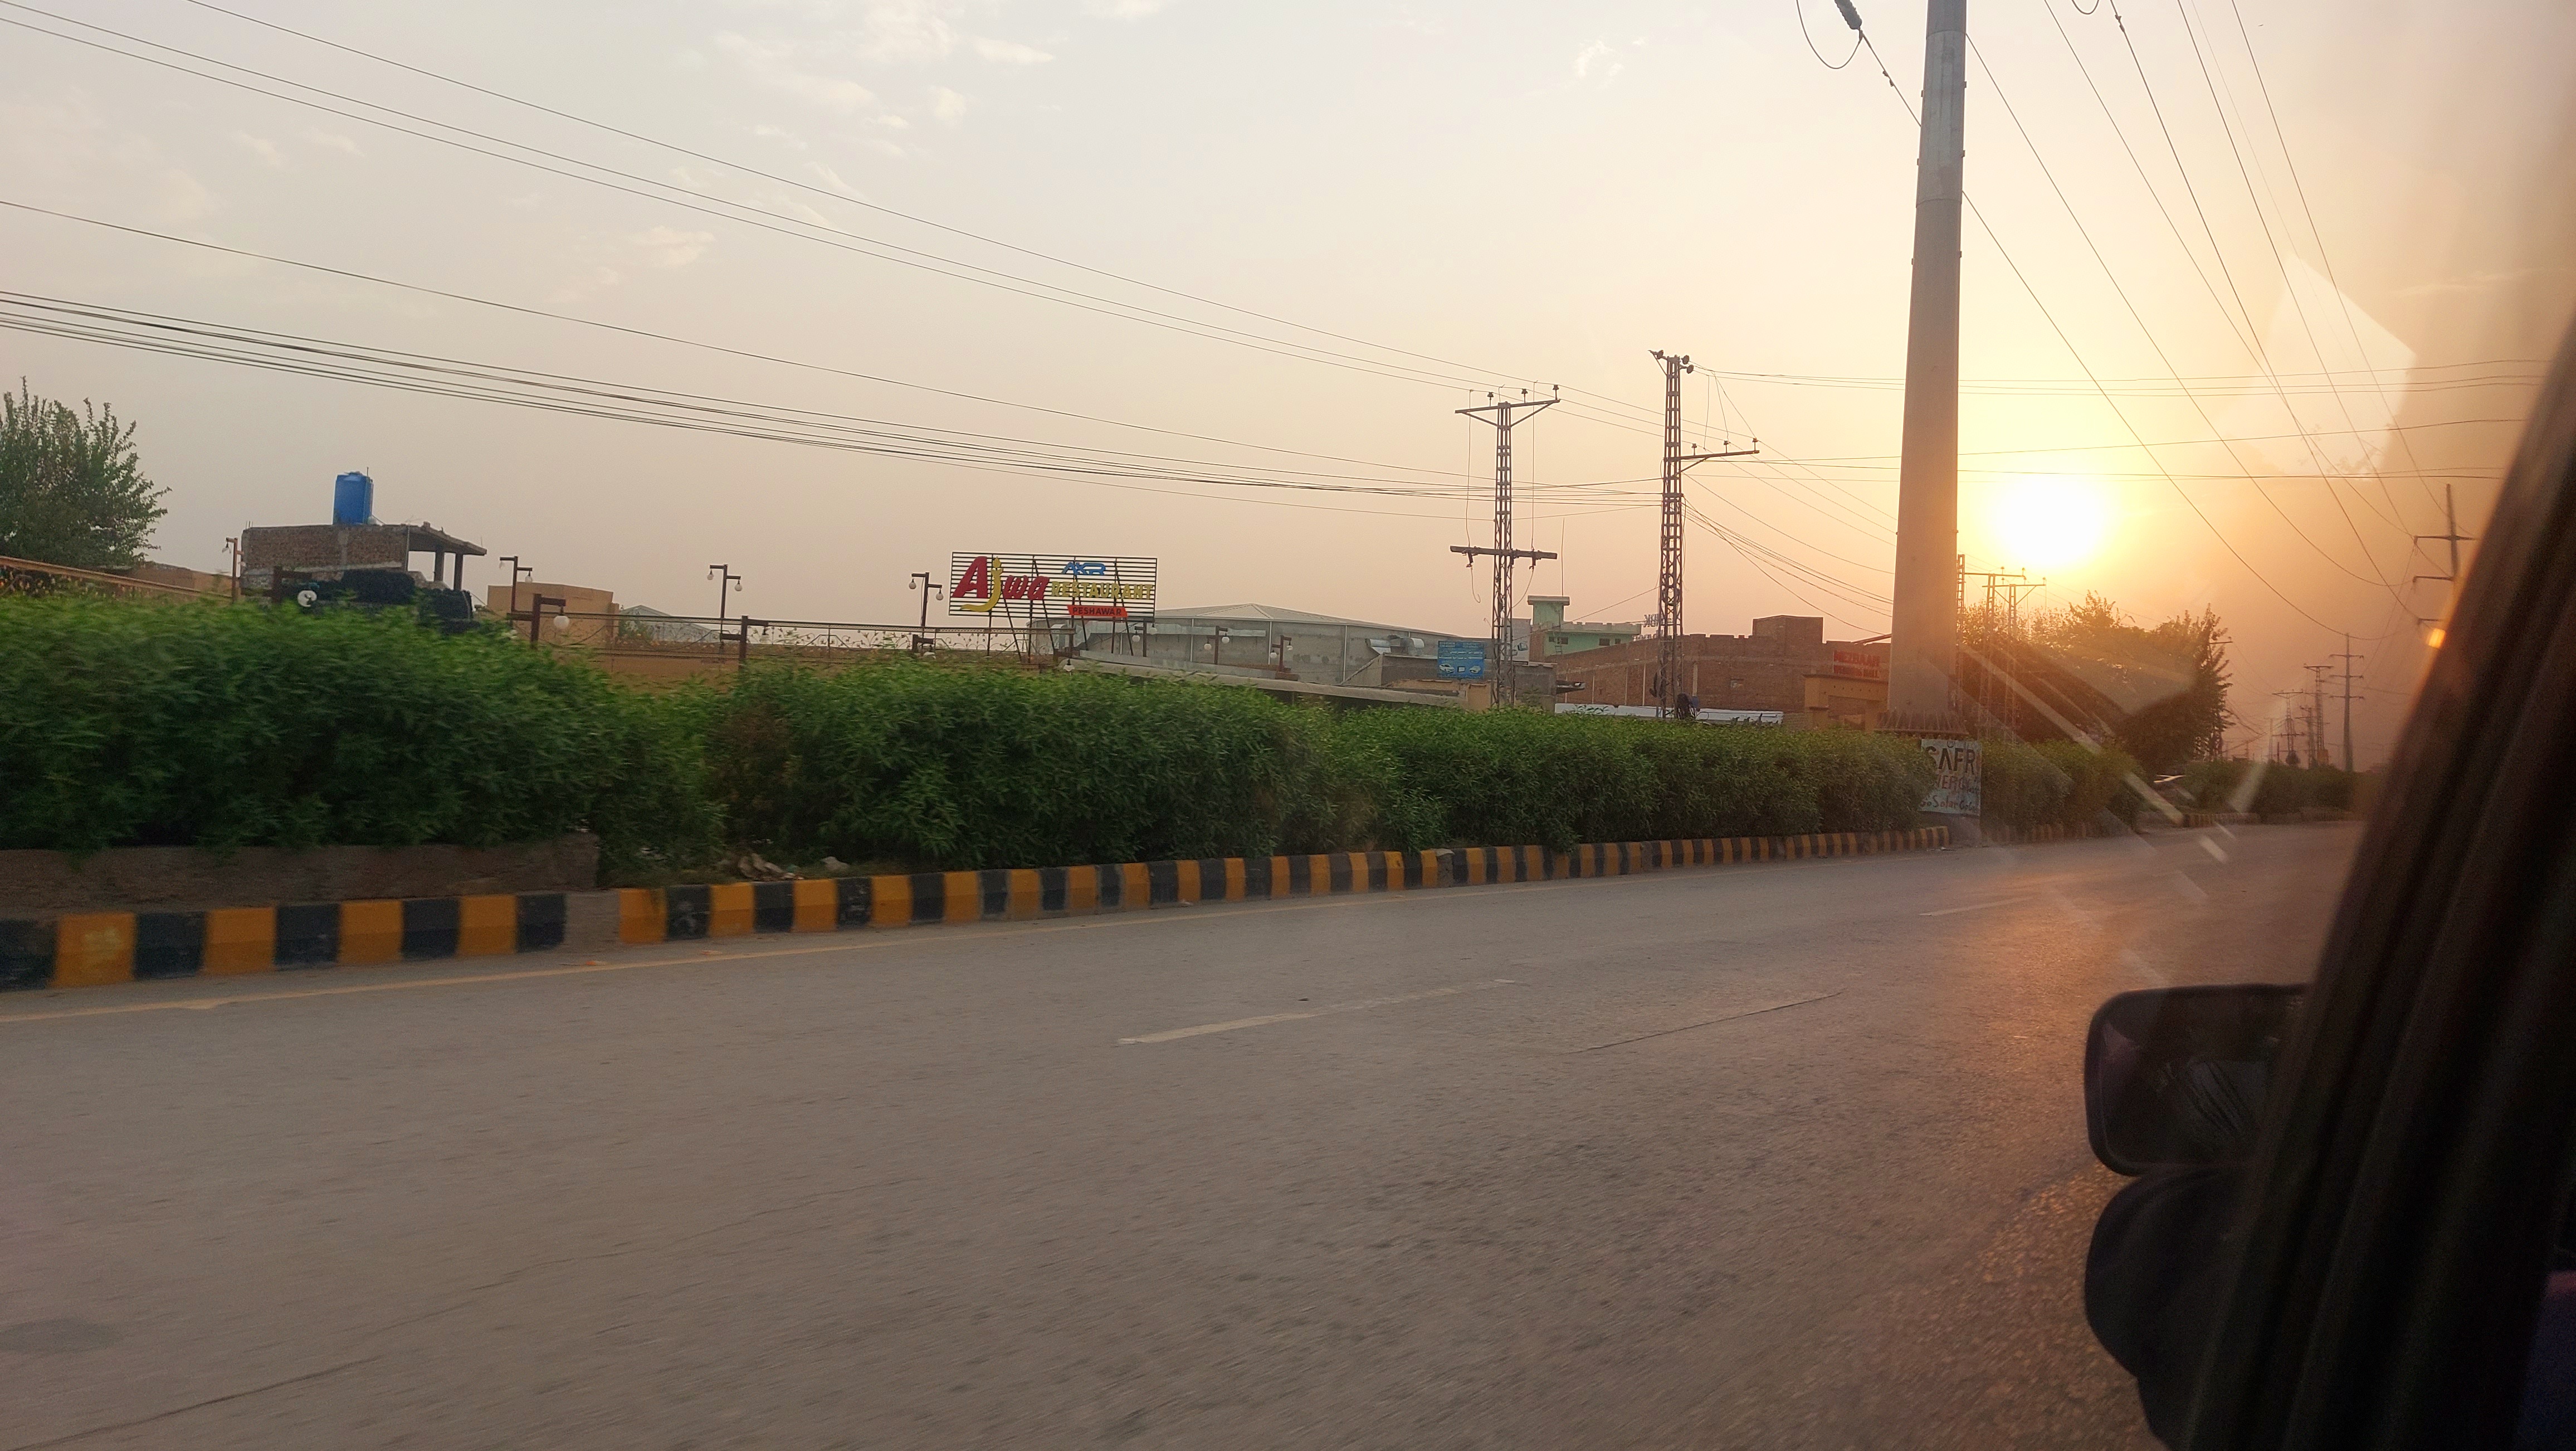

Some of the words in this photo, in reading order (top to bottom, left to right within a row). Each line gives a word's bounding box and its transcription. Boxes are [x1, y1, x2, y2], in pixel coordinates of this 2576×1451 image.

[952, 556, 1050, 612] Ajwa
[1051, 581, 1153, 600] RESTAURANT
[1072, 607, 1121, 615] PESHAWAR
